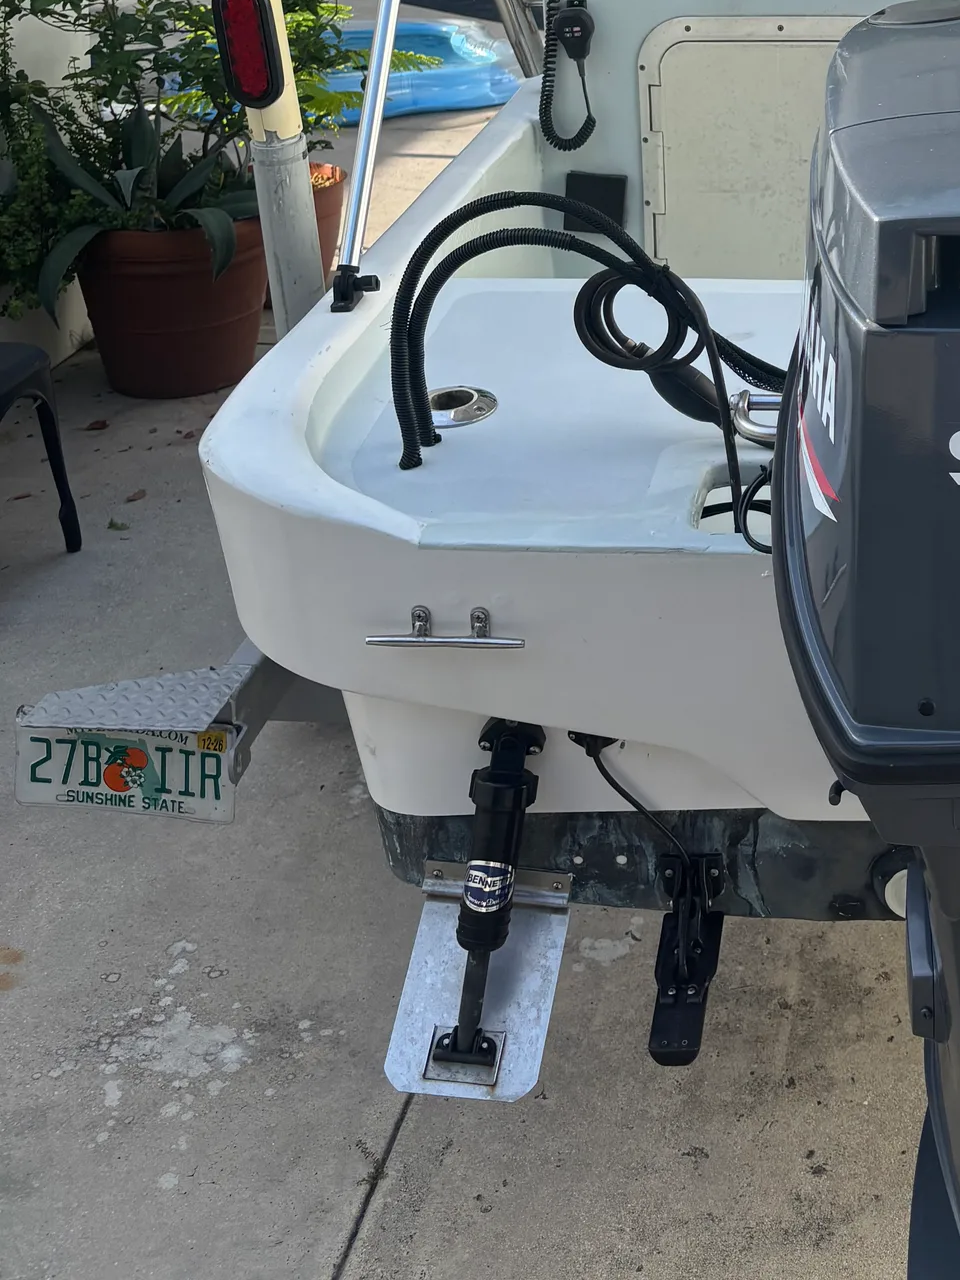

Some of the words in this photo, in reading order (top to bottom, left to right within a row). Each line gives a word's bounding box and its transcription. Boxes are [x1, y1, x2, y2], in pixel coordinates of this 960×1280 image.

[29, 736, 101, 787] 27B
[154, 746, 222, 801] IIR
[66, 789, 135, 808] SUNSHINE
[142, 796, 185, 814] STATE
